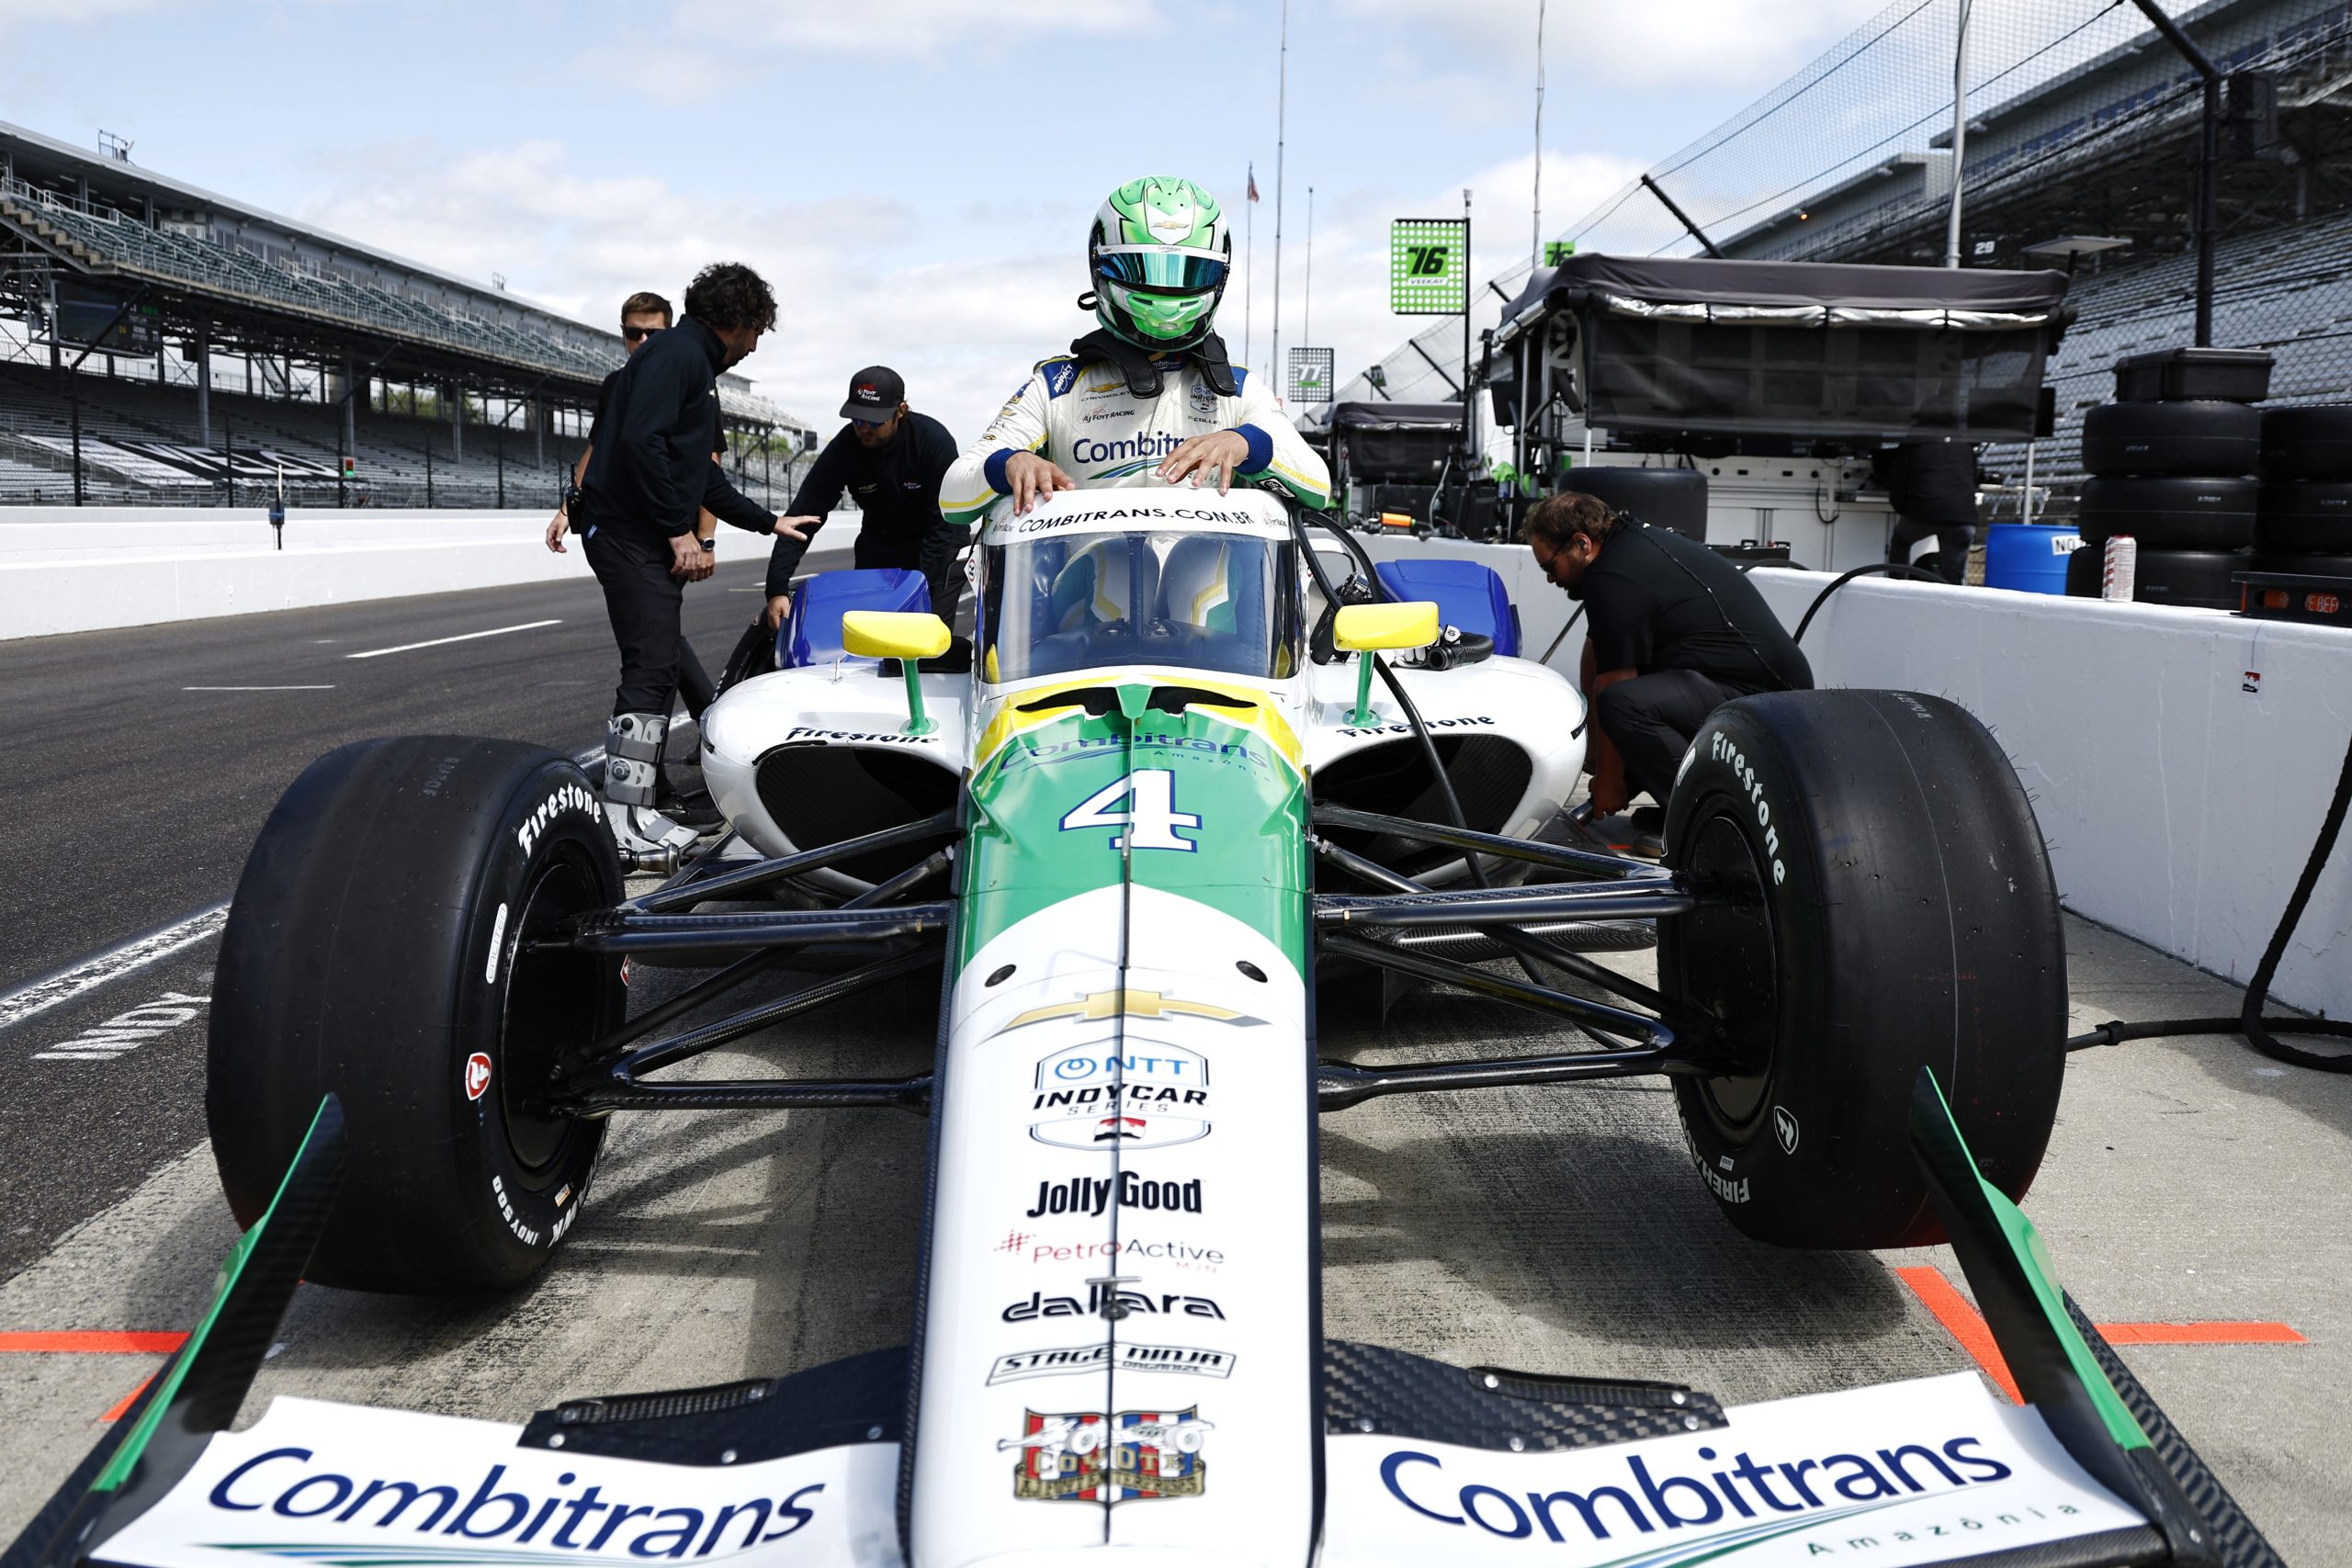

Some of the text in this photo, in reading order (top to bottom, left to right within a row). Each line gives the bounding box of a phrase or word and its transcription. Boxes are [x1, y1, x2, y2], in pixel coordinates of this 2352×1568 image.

[1407, 245, 1449, 276] 76
[1409, 277, 1446, 286] VEEKAY
[1053, 363, 1074, 394] IMPACT
[1296, 363, 1322, 381] 77
[1080, 390, 1131, 402] CHEVROLET
[1110, 410, 1136, 418] RACING
[1072, 430, 1186, 465] Combitr
[1018, 507, 1256, 534] COMBITRANS.COM.BR
[785, 727, 939, 744] Firestone
[1336, 716, 1496, 738] Firetone
[1000, 731, 1269, 771] Combitrans
[517, 782, 602, 859] Firestone
[1057, 767, 1203, 853] 4
[1712, 730, 1786, 886] Firestone
[1104, 1055, 1190, 1076] NTT
[1032, 1082, 1209, 1111] INDYCAR
[1066, 1100, 1170, 1116] SERIES
[1025, 1169, 1203, 1219] Jolly Good
[1004, 1346, 1224, 1370] STAGE NINJA
[207, 1446, 827, 1560] Combitrans
[1379, 1436, 2013, 1544] Combitrans
[1806, 1503, 2081, 1557] Amazônia
